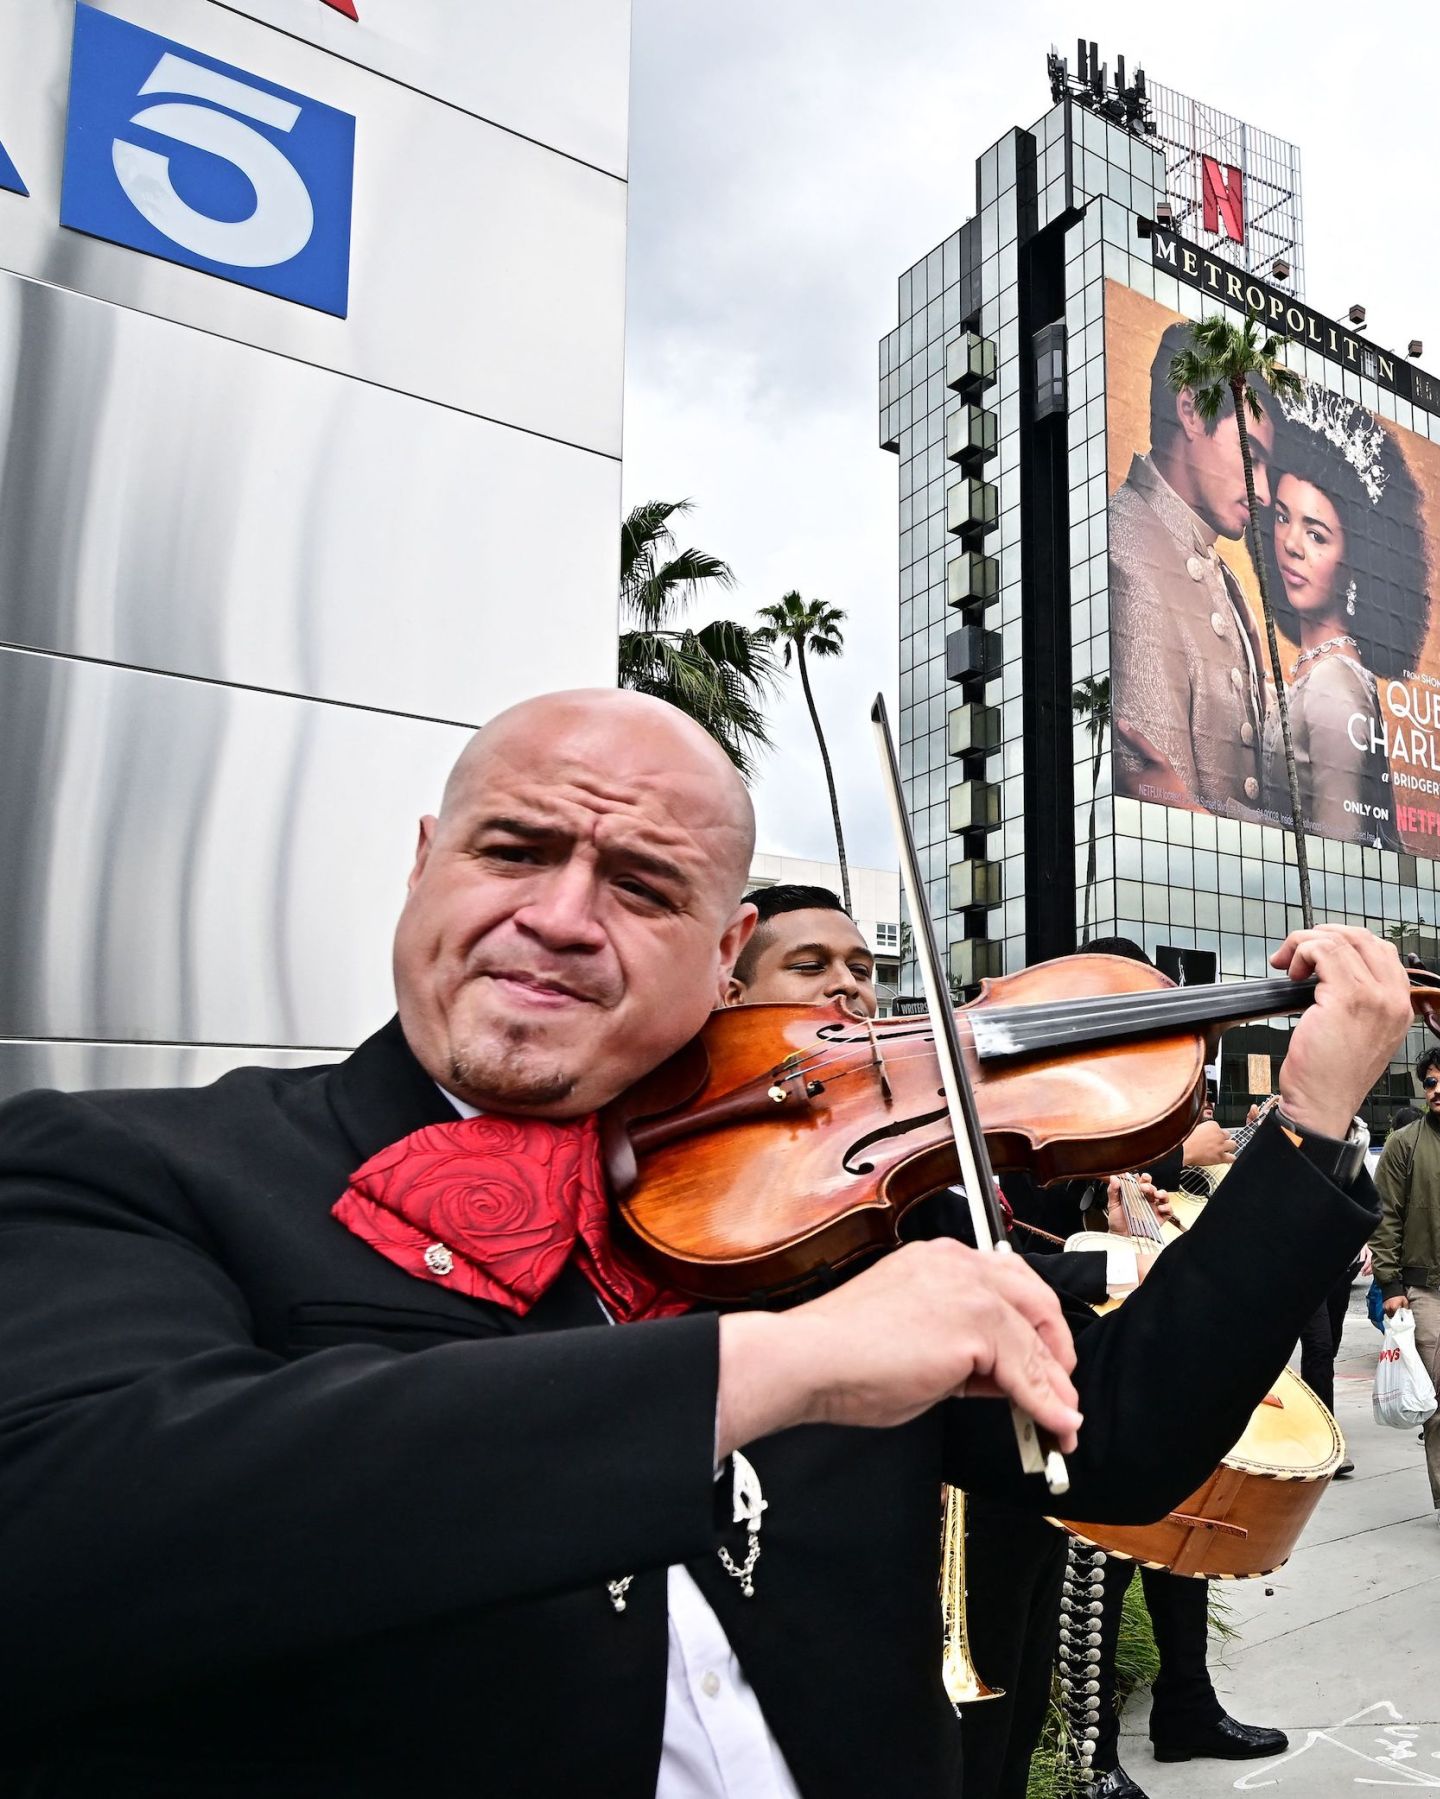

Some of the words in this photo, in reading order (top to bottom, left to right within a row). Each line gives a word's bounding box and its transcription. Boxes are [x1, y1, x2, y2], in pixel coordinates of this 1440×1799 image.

[112, 52, 314, 267] 5
[1202, 154, 1243, 246] N
[1154, 233, 1394, 383] METROPOLITN
[1381, 771, 1390, 783] a
[1343, 800, 1371, 817] ONLY
[1373, 807, 1389, 821] ON
[901, 1002, 929, 1015] WRITERS
